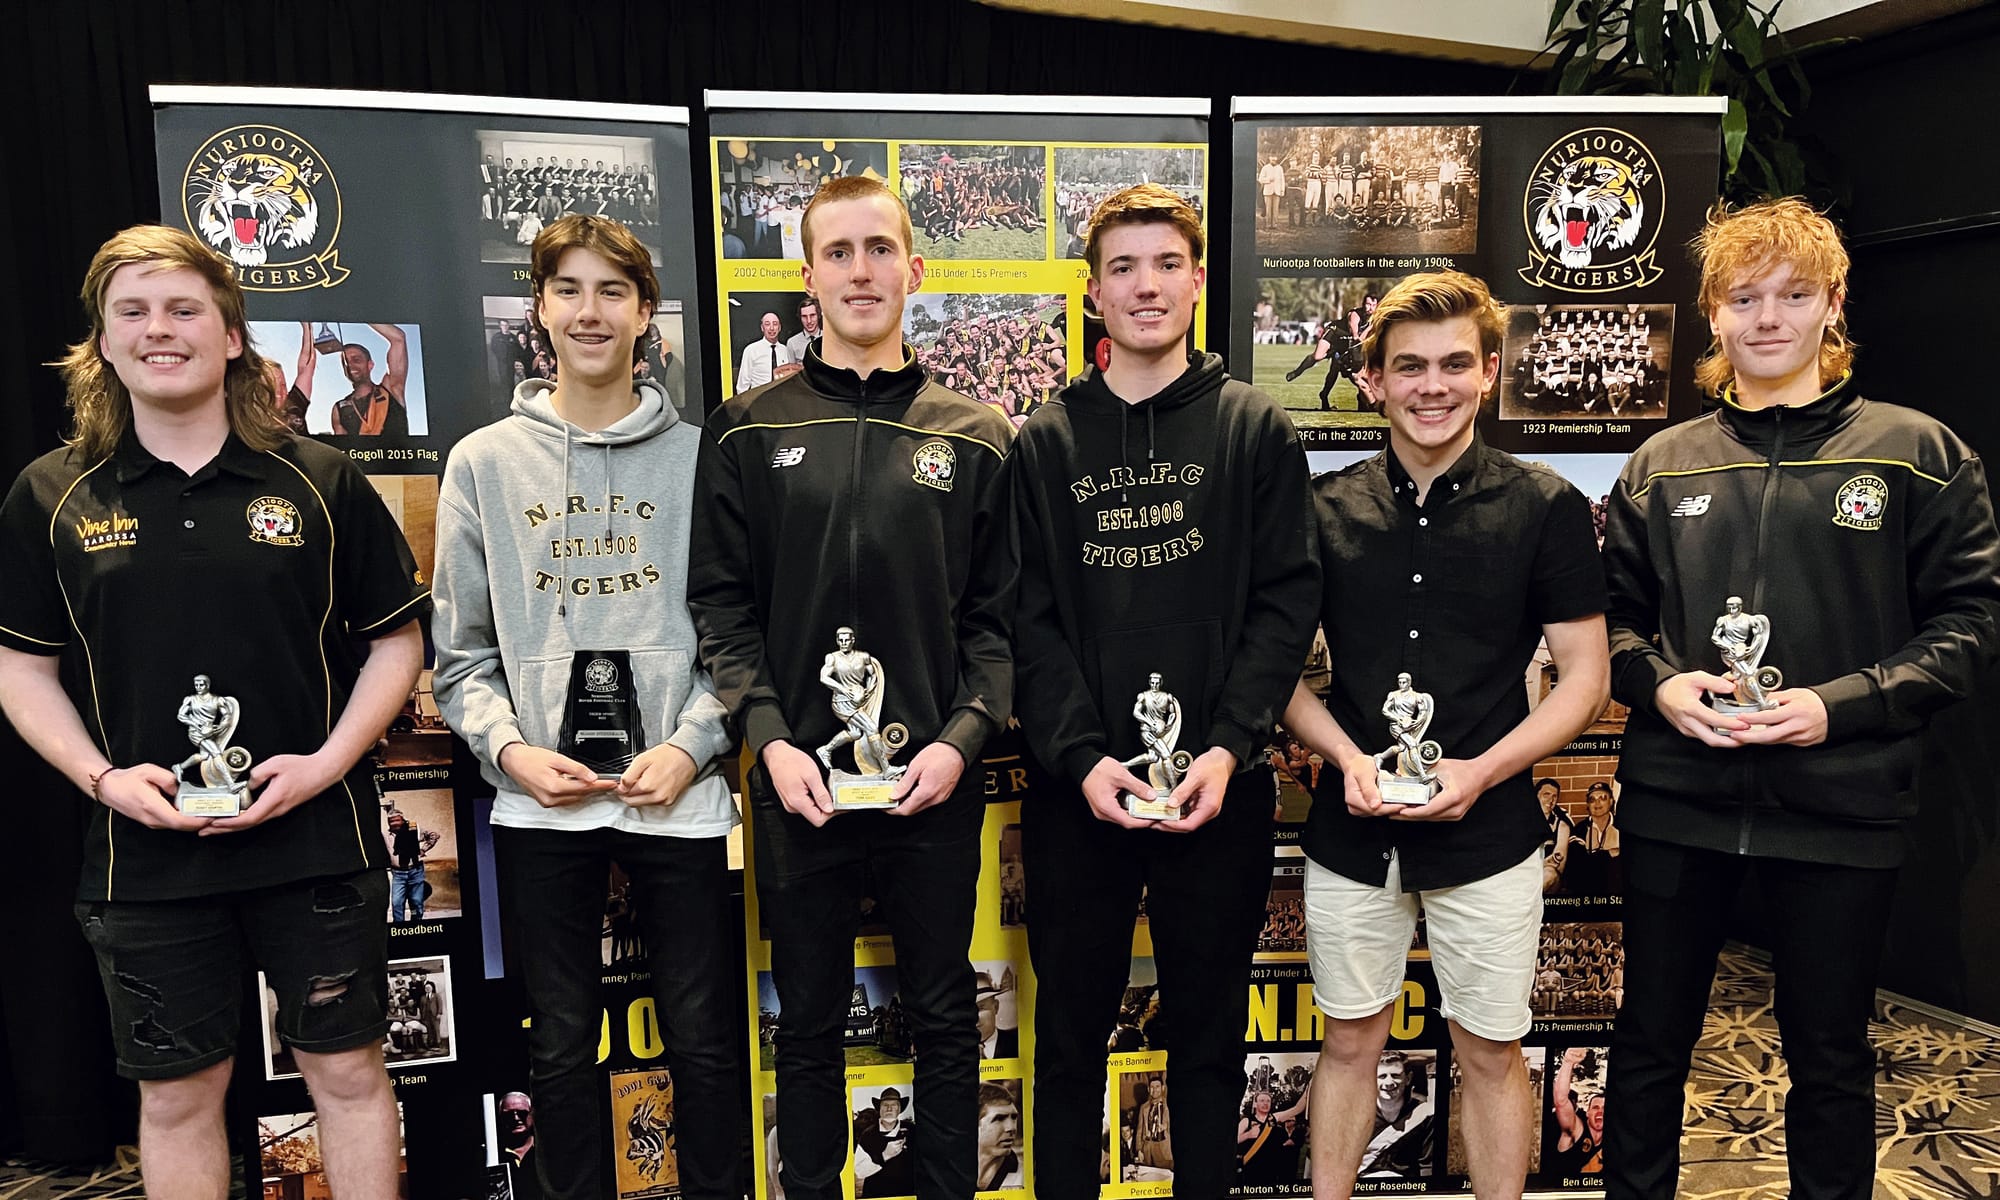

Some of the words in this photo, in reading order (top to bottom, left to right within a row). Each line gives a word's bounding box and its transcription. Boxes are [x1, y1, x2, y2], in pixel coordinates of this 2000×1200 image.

[195, 133, 323, 184] NURIOOTPA
[1539, 136, 1653, 187] NURIOOTPA
[1263, 257, 1310, 270] Nuriootpa
[1313, 257, 1365, 268] footballers
[1367, 257, 1376, 267] in
[1379, 257, 1395, 267] the
[1397, 257, 1422, 270] early
[1424, 257, 1456, 267] 1900s.
[237, 265, 317, 285] IGERS
[513, 270, 531, 281] 194
[734, 267, 757, 278] 2002
[760, 267, 801, 279] Changero
[924, 268, 941, 278] 016
[943, 268, 968, 278] Under
[971, 268, 988, 278] 15s
[990, 268, 1028, 278] Premiers
[1076, 269, 1088, 278] 20
[1550, 265, 1634, 286] TIGERS
[1297, 430, 1316, 440] RFC
[1318, 430, 1327, 440] in
[1331, 430, 1347, 440] the
[1350, 430, 1382, 440] 2020's
[1522, 423, 1546, 434] 1923
[1549, 423, 1603, 435] Premiership
[1606, 423, 1631, 433] Team
[349, 449, 384, 461] Gogoll
[387, 449, 414, 459] 2015
[417, 449, 439, 461] Flag
[1097, 500, 1184, 532] EST.1908
[75, 515, 110, 539] Vine
[113, 512, 139, 533] Inn
[84, 532, 137, 546] BAROSSA
[1082, 527, 1205, 568] TIGERS
[535, 563, 662, 597] TIGERS
[1564, 742, 1597, 750] rooms
[1600, 740, 1609, 750] in
[388, 769, 449, 780] Premiership
[984, 768, 1029, 795] ER
[1544, 897, 1581, 907] enzweig
[1583, 896, 1591, 905] &
[390, 924, 444, 937] Broadbent
[602, 973, 628, 984] mney
[631, 971, 651, 981] Pain
[1274, 968, 1300, 978] Under
[848, 1005, 868, 1018] MS
[1534, 1023, 1550, 1032] 17s
[1552, 1022, 1603, 1032] Premiership
[980, 1065, 1004, 1073] erman
[399, 1075, 427, 1085] Team
[1355, 1182, 1378, 1191] Peter
[1380, 1181, 1427, 1191] Rosenberg
[1461, 1180, 1472, 1189] Ja
[1563, 1177, 1579, 1187] Ben
[1582, 1177, 1604, 1186] Giles
[1229, 1187, 1240, 1195] an
[1243, 1185, 1273, 1194] Norton
[1292, 1184, 1313, 1193] Gran
